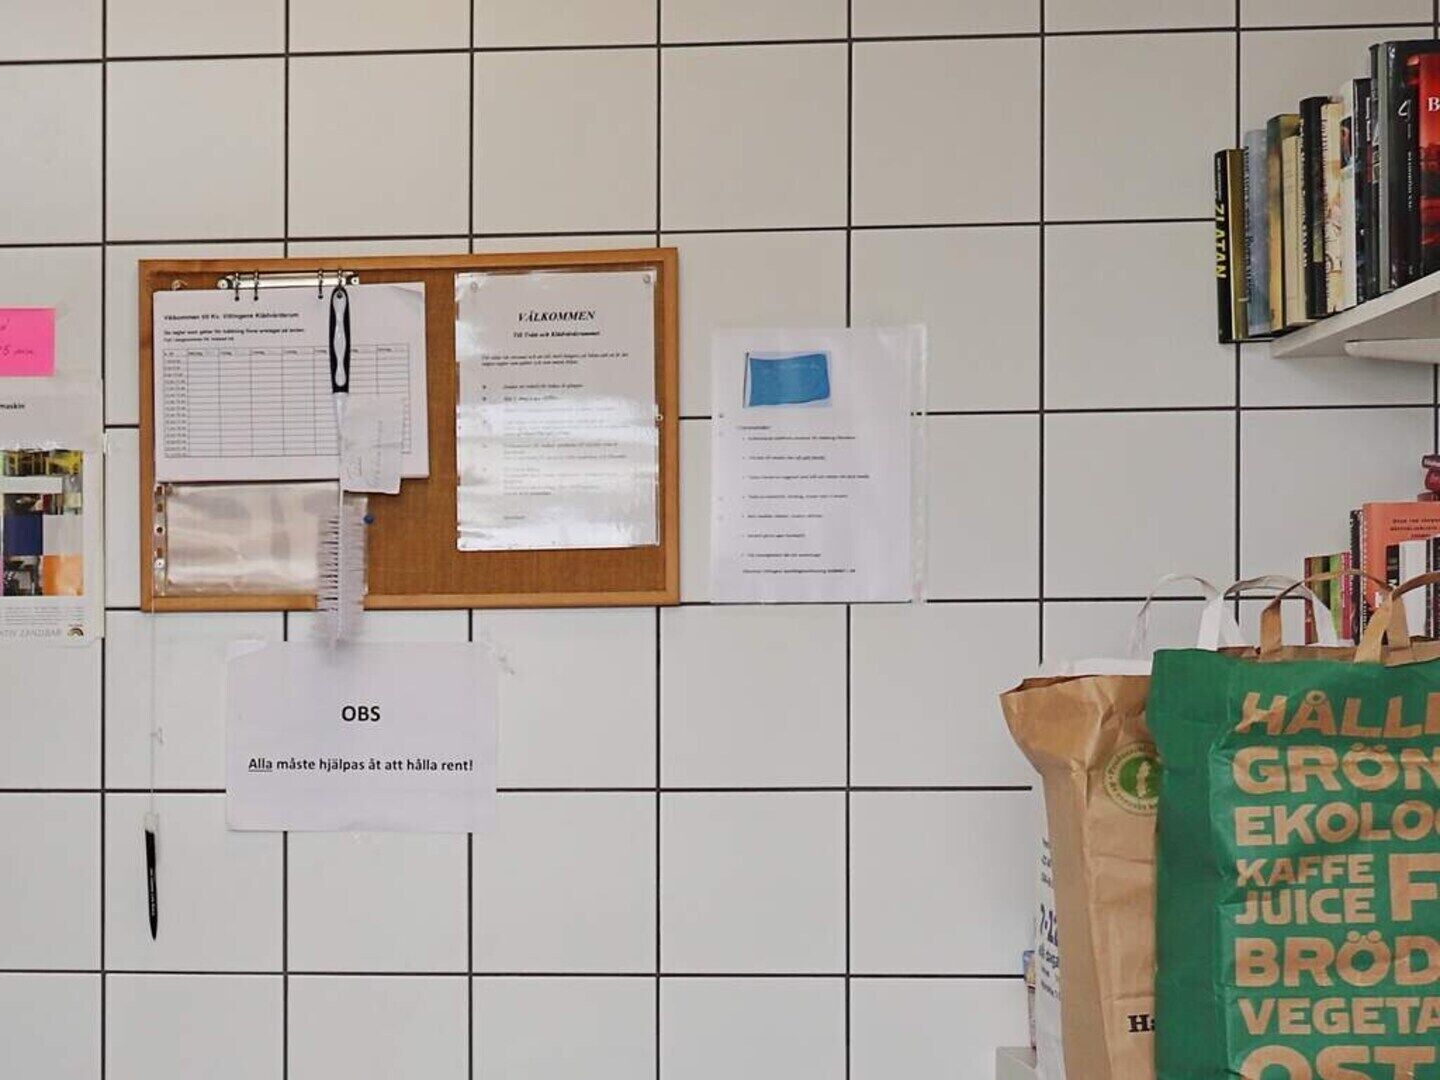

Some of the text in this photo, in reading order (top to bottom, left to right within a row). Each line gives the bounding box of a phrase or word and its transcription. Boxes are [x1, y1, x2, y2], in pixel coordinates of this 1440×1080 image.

[517, 310, 596, 322] VÄLKOMMEN
[341, 705, 381, 722] OBS
[248, 757, 474, 773] Alla måste hjälpas åt att hålla rent!
[1232, 742, 1440, 794] GRÖN
[1234, 800, 1440, 847] EKOLO
[1235, 853, 1375, 887] KAFFE
[1234, 888, 1376, 925] JUICE
[1234, 930, 1440, 988] BRÖD
[1237, 996, 1440, 1036] VEGETA
